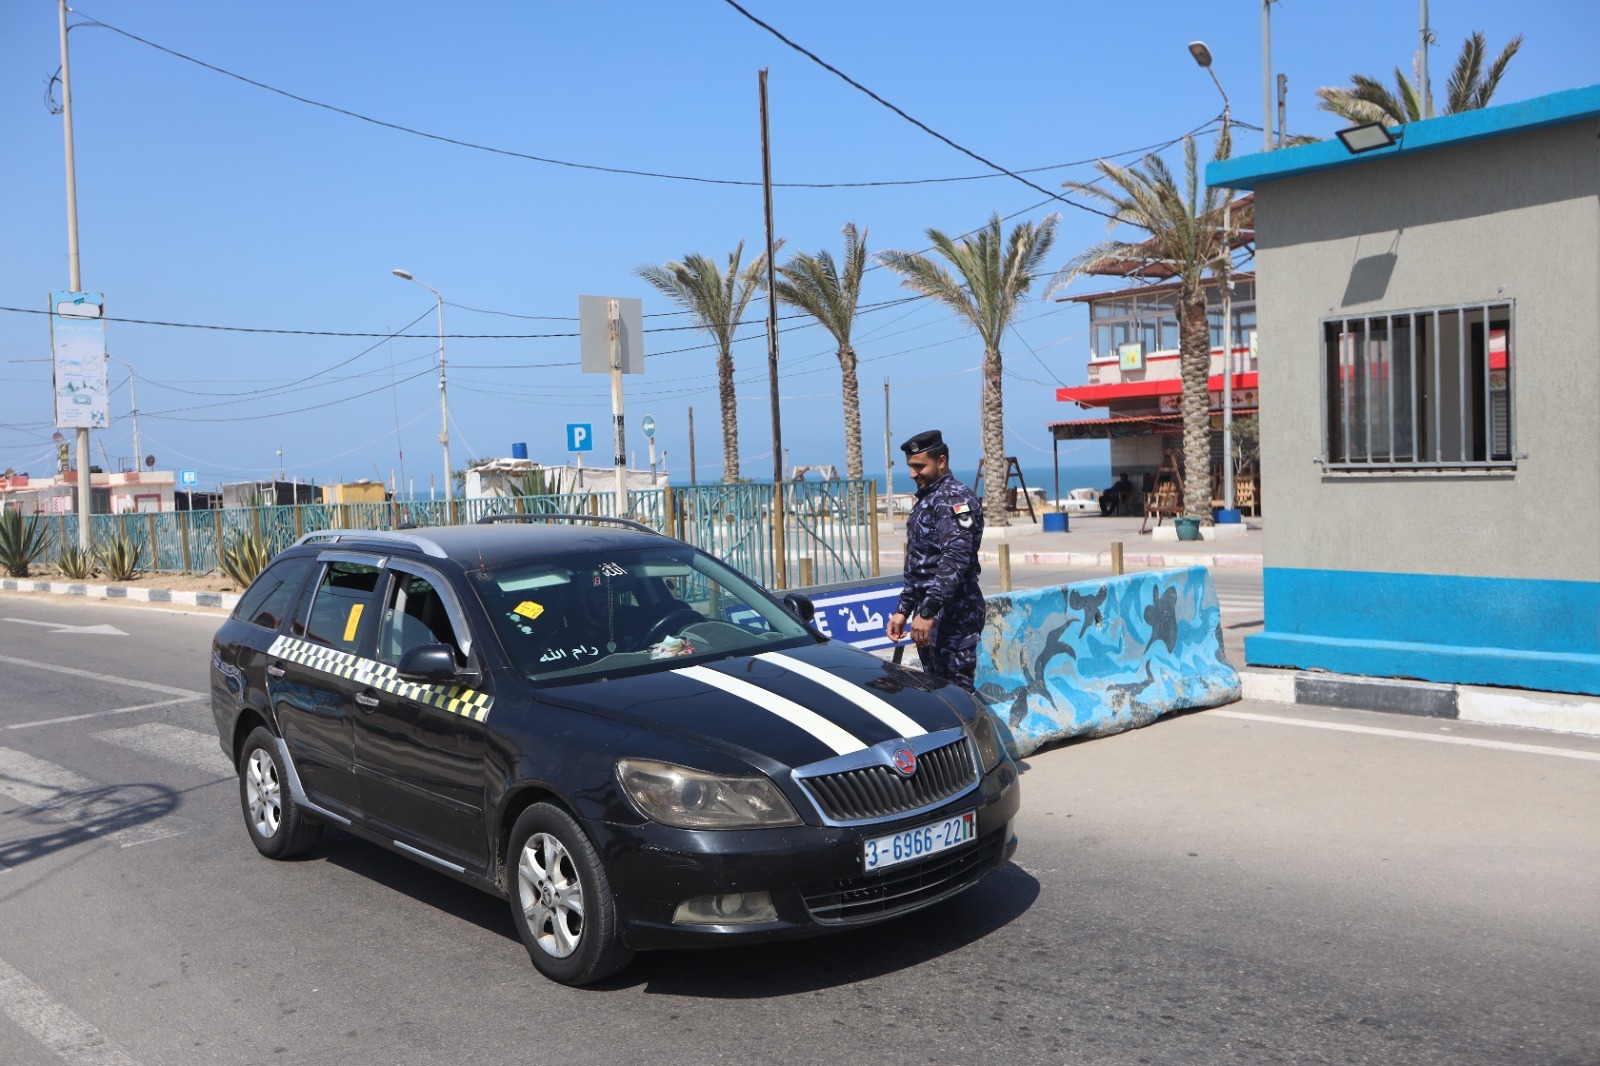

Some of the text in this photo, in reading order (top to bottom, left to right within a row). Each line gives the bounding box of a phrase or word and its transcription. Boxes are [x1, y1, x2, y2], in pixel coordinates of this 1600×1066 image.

[574, 427, 587, 448] P
[539, 644, 599, 662] رام الله
[867, 818, 962, 867] 3-6966-22
